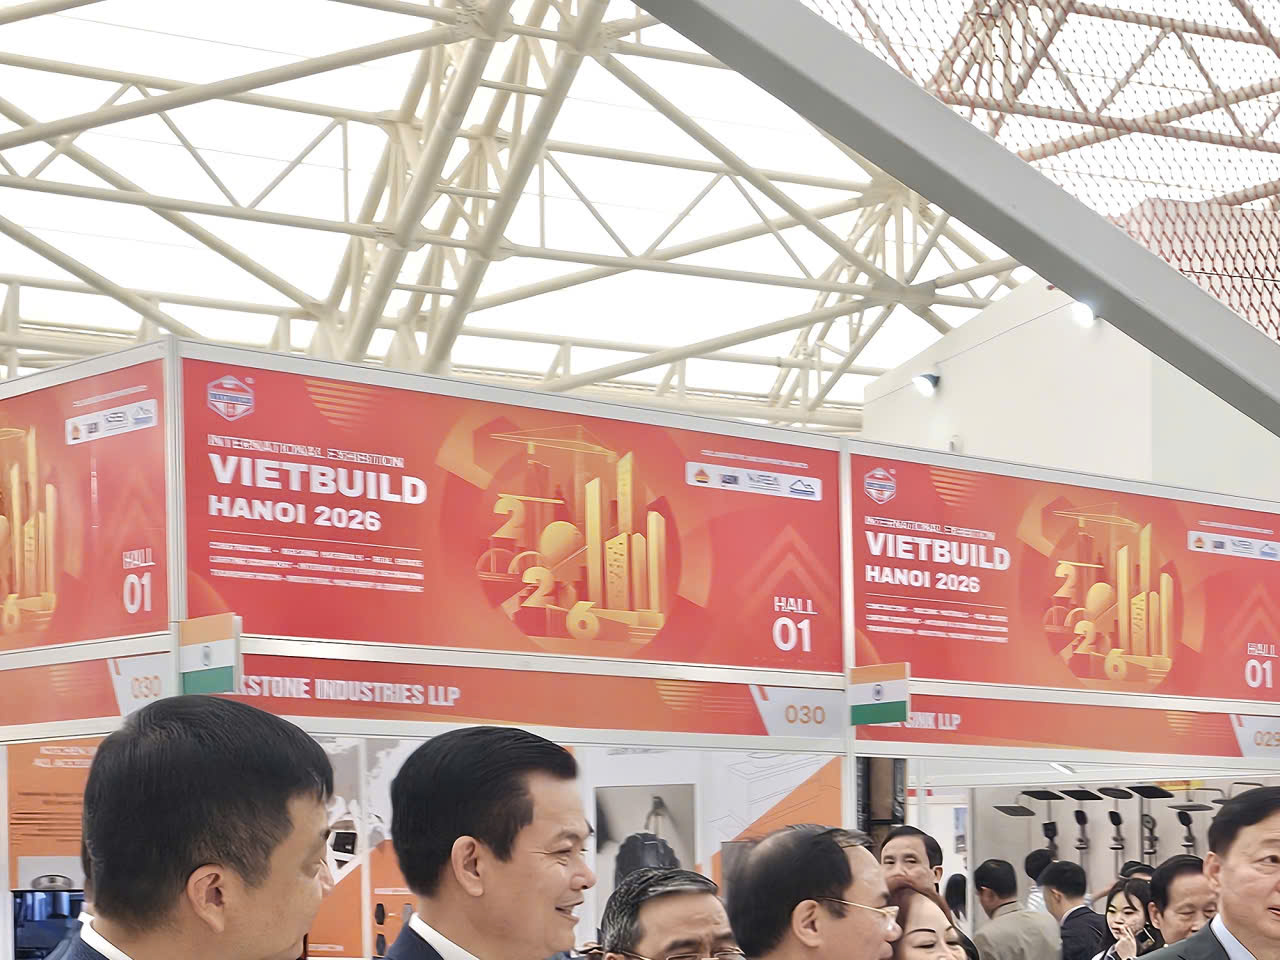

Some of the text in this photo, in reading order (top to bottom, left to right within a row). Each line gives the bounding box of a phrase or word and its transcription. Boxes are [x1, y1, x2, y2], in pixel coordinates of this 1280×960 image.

[208, 453, 428, 505] VIETBUILD
[208, 495, 382, 532] HANOI 2026
[865, 531, 1011, 571] VIETBUILD
[123, 571, 152, 614] 01
[865, 565, 981, 593] HANOI 2026
[773, 596, 819, 615] HALL
[772, 617, 811, 652] 01
[1245, 659, 1273, 688] 01
[315, 679, 424, 705] INDUSTRIES
[427, 685, 460, 706] LLP
[785, 704, 826, 724] 030
